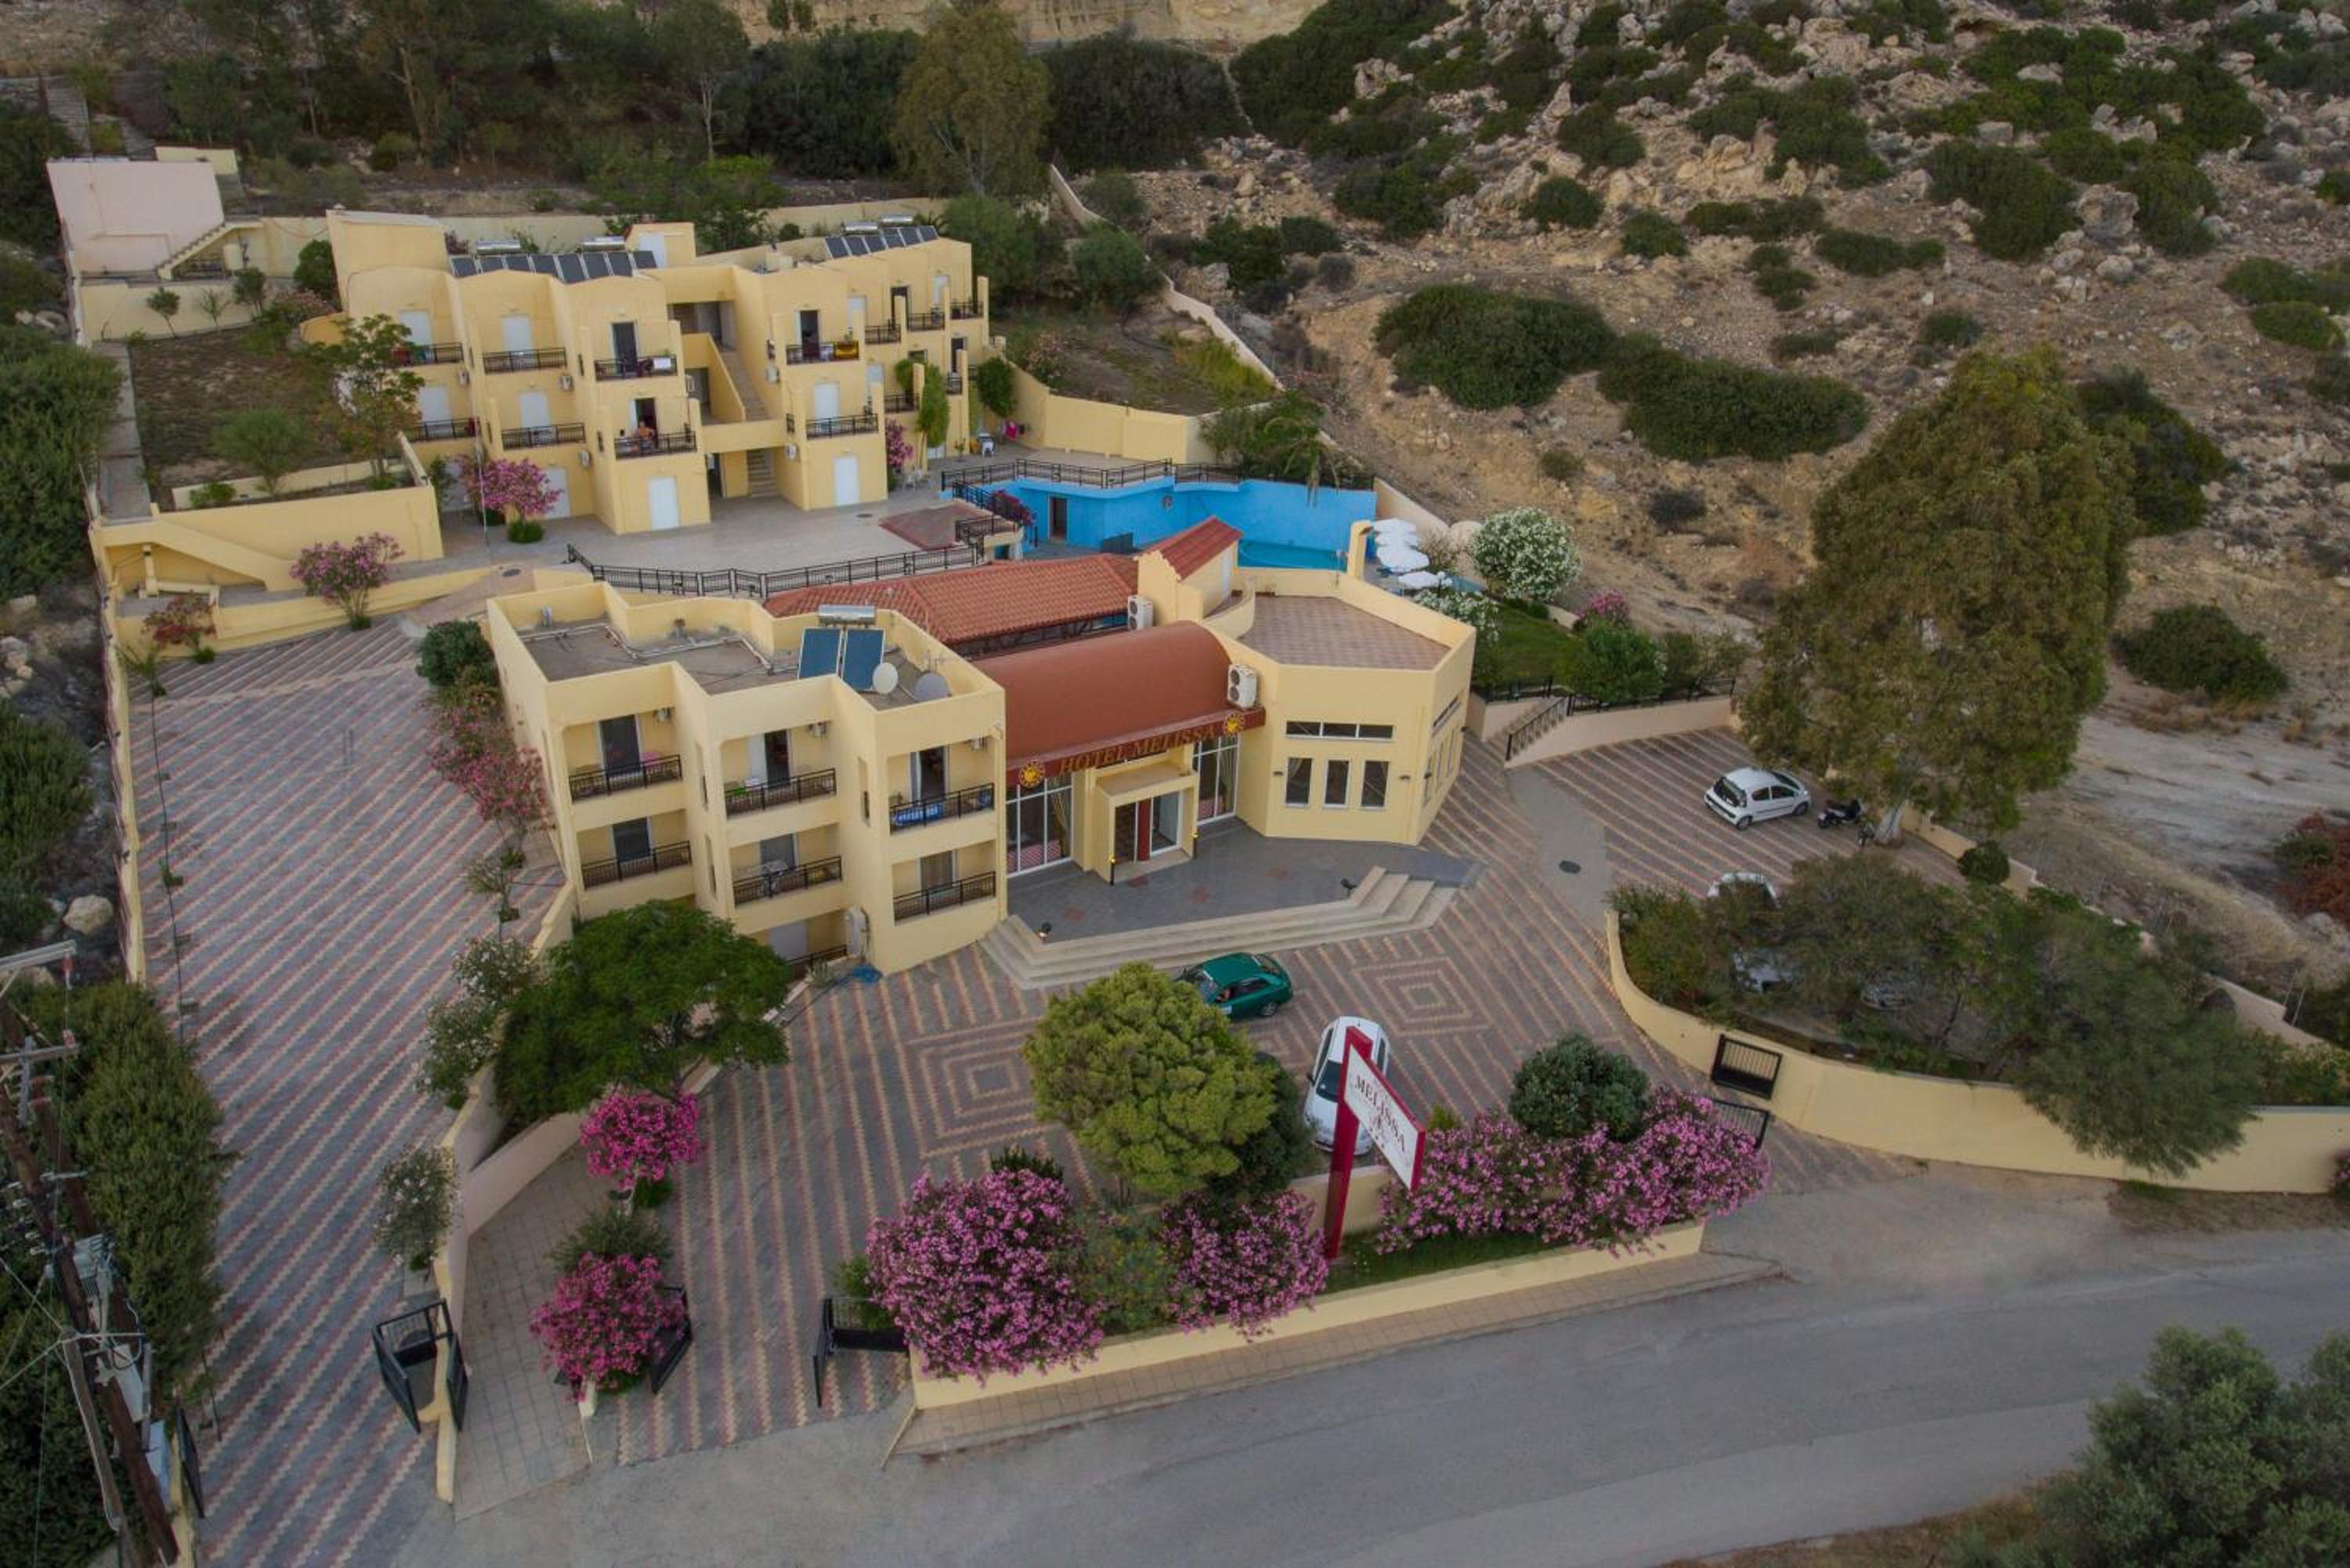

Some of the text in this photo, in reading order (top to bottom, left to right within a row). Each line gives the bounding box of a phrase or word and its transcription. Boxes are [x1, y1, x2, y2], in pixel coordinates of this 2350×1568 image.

[1061, 727, 1216, 774] HOTEL MELISSA
[1355, 1075, 1405, 1151] MELISSA
